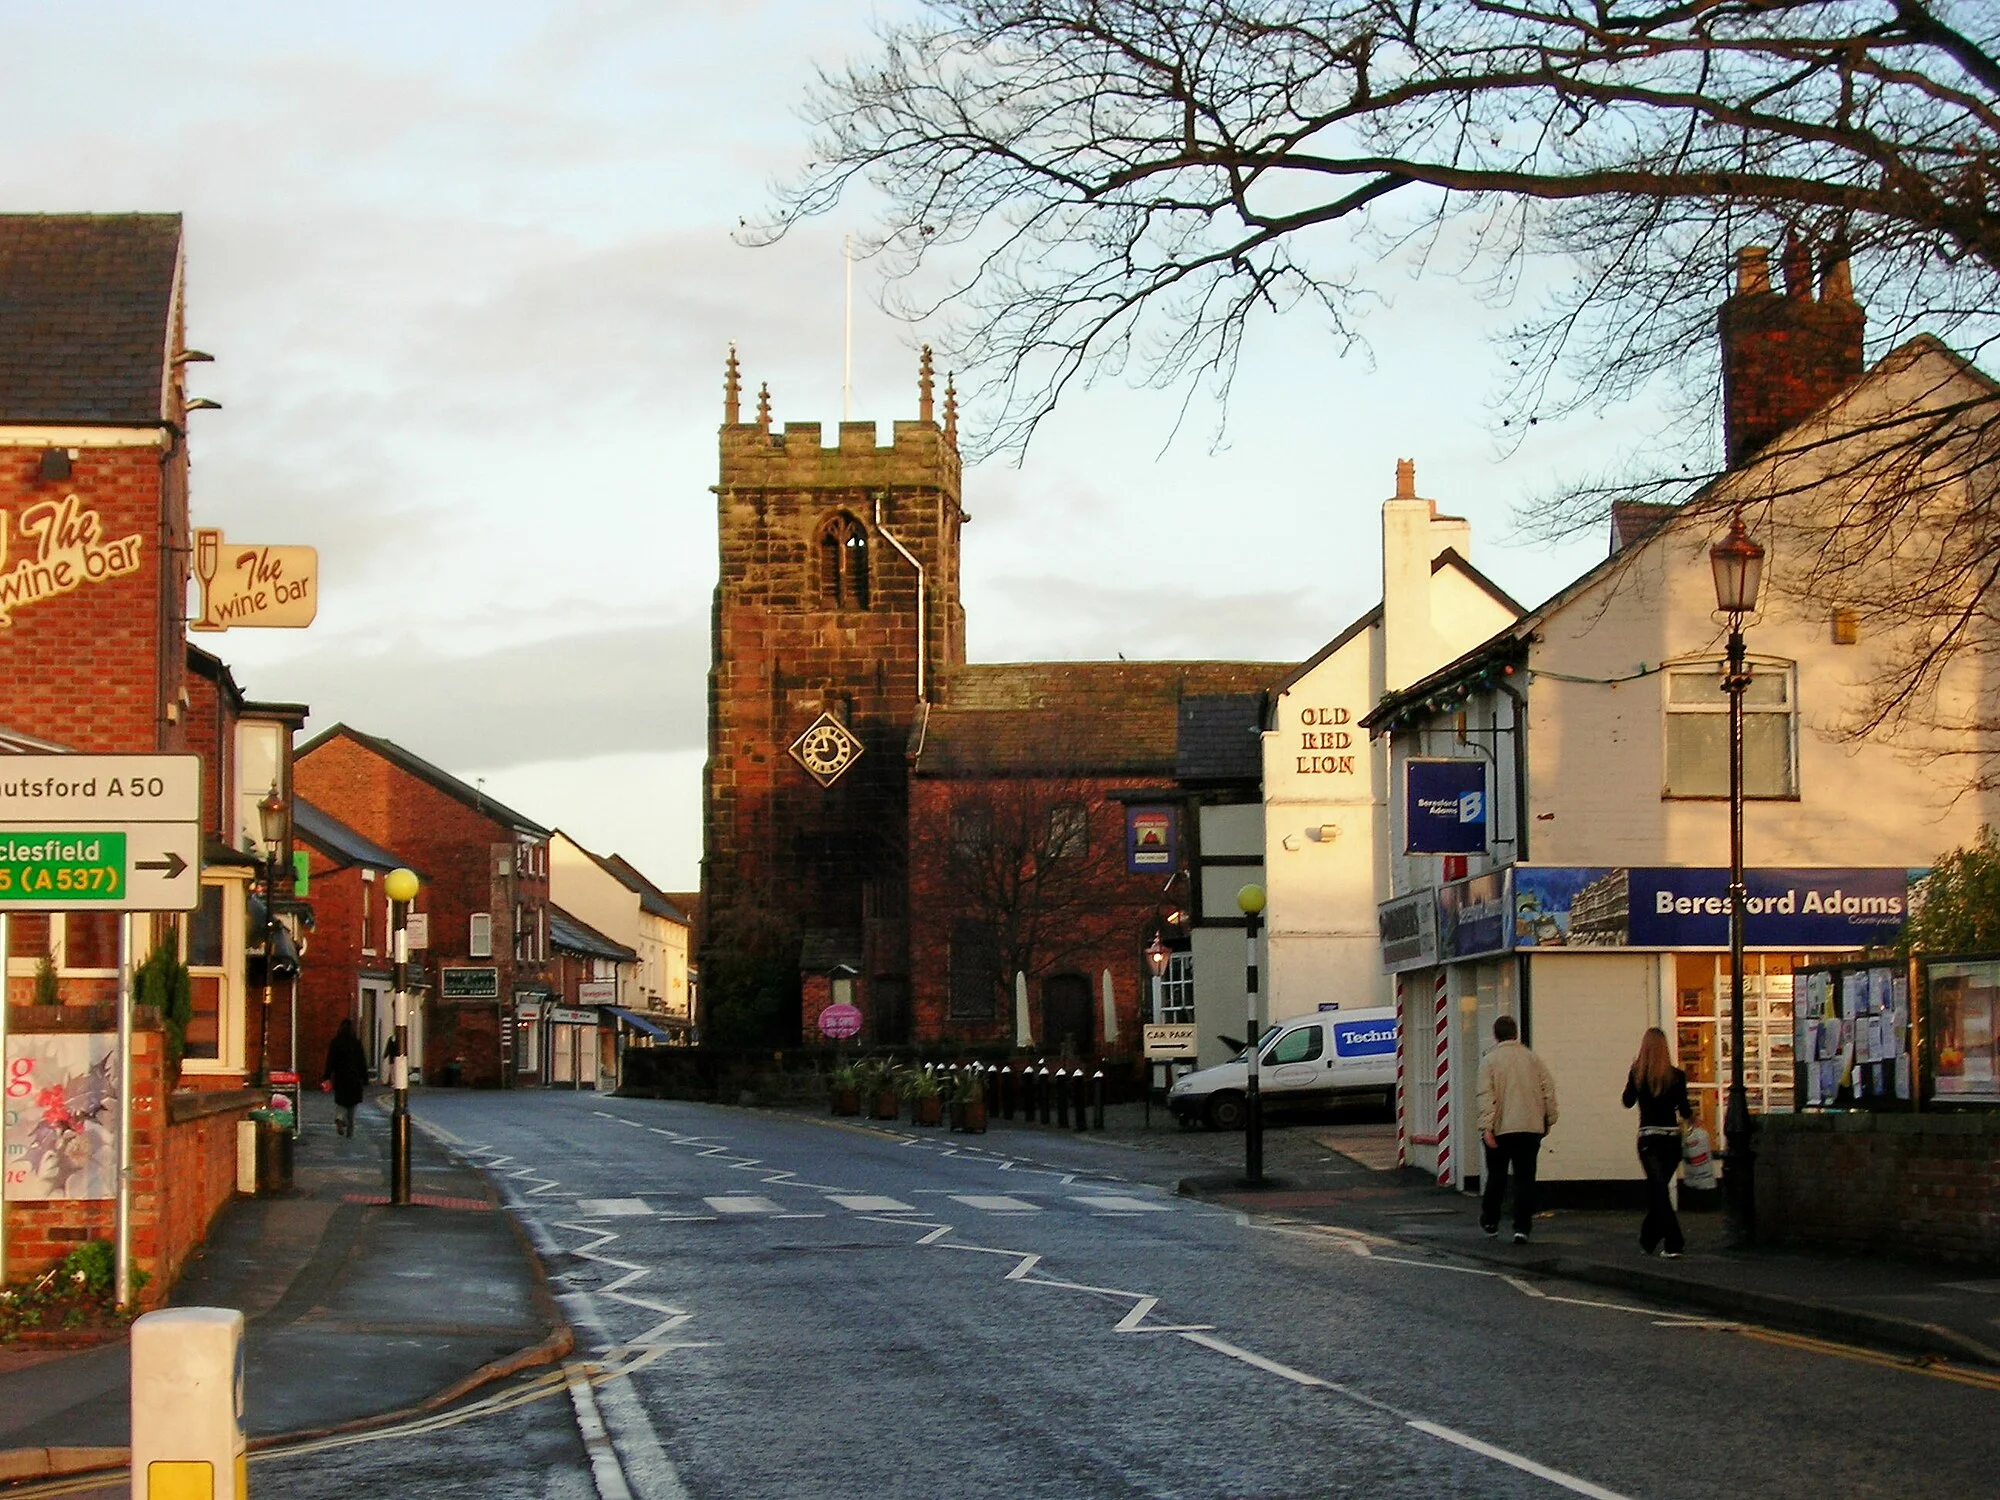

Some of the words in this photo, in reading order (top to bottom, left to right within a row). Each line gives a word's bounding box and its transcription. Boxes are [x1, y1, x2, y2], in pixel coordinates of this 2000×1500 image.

[23, 498, 97, 560] The
[0, 561, 74, 605] wine
[82, 539, 136, 578] bar
[236, 547, 283, 590] The
[215, 594, 267, 621] wine
[273, 576, 309, 605] bar
[1301, 707, 1350, 726] OLD
[1301, 731, 1352, 750] RED
[1296, 756, 1355, 775] LION
[0, 777, 96, 798] utsford
[107, 777, 164, 798] A50
[1429, 806, 1458, 815] Adams
[1460, 791, 1482, 823] B
[1656, 890, 1796, 915] Beresord
[1802, 890, 1902, 915] Adams
[1169, 1030, 1193, 1039] PARK
